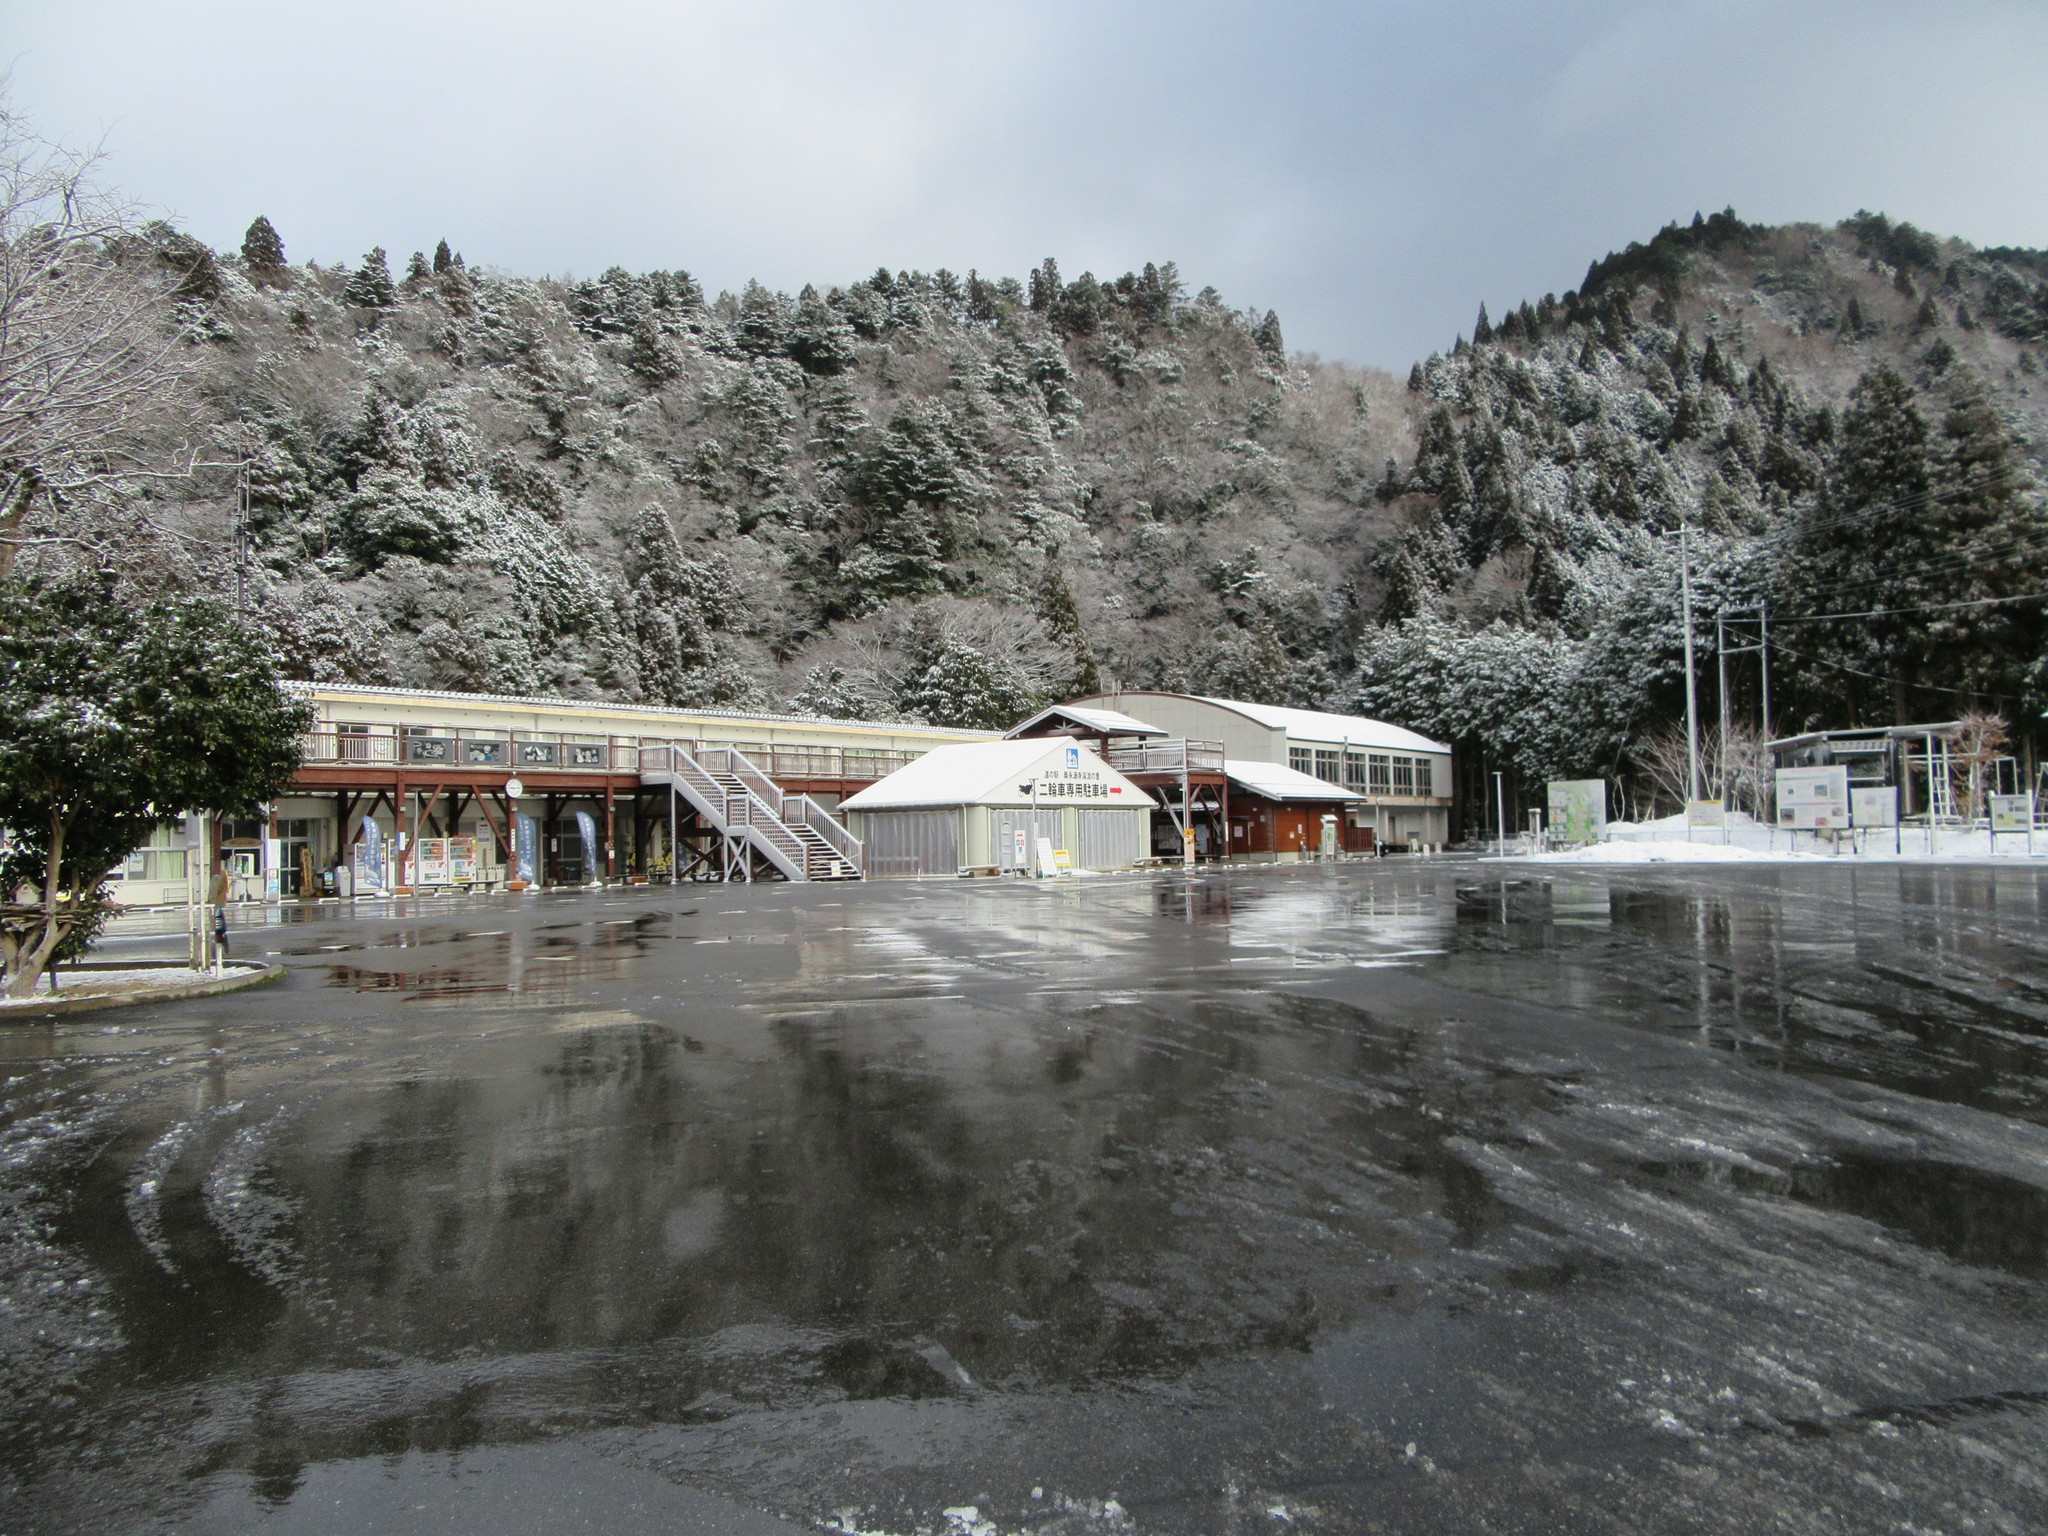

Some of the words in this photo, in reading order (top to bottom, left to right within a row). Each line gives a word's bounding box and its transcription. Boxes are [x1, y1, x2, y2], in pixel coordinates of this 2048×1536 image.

[1044, 771, 1058, 779] 道の駅
[1039, 782, 1108, 798] 二輪車専用駐車場
